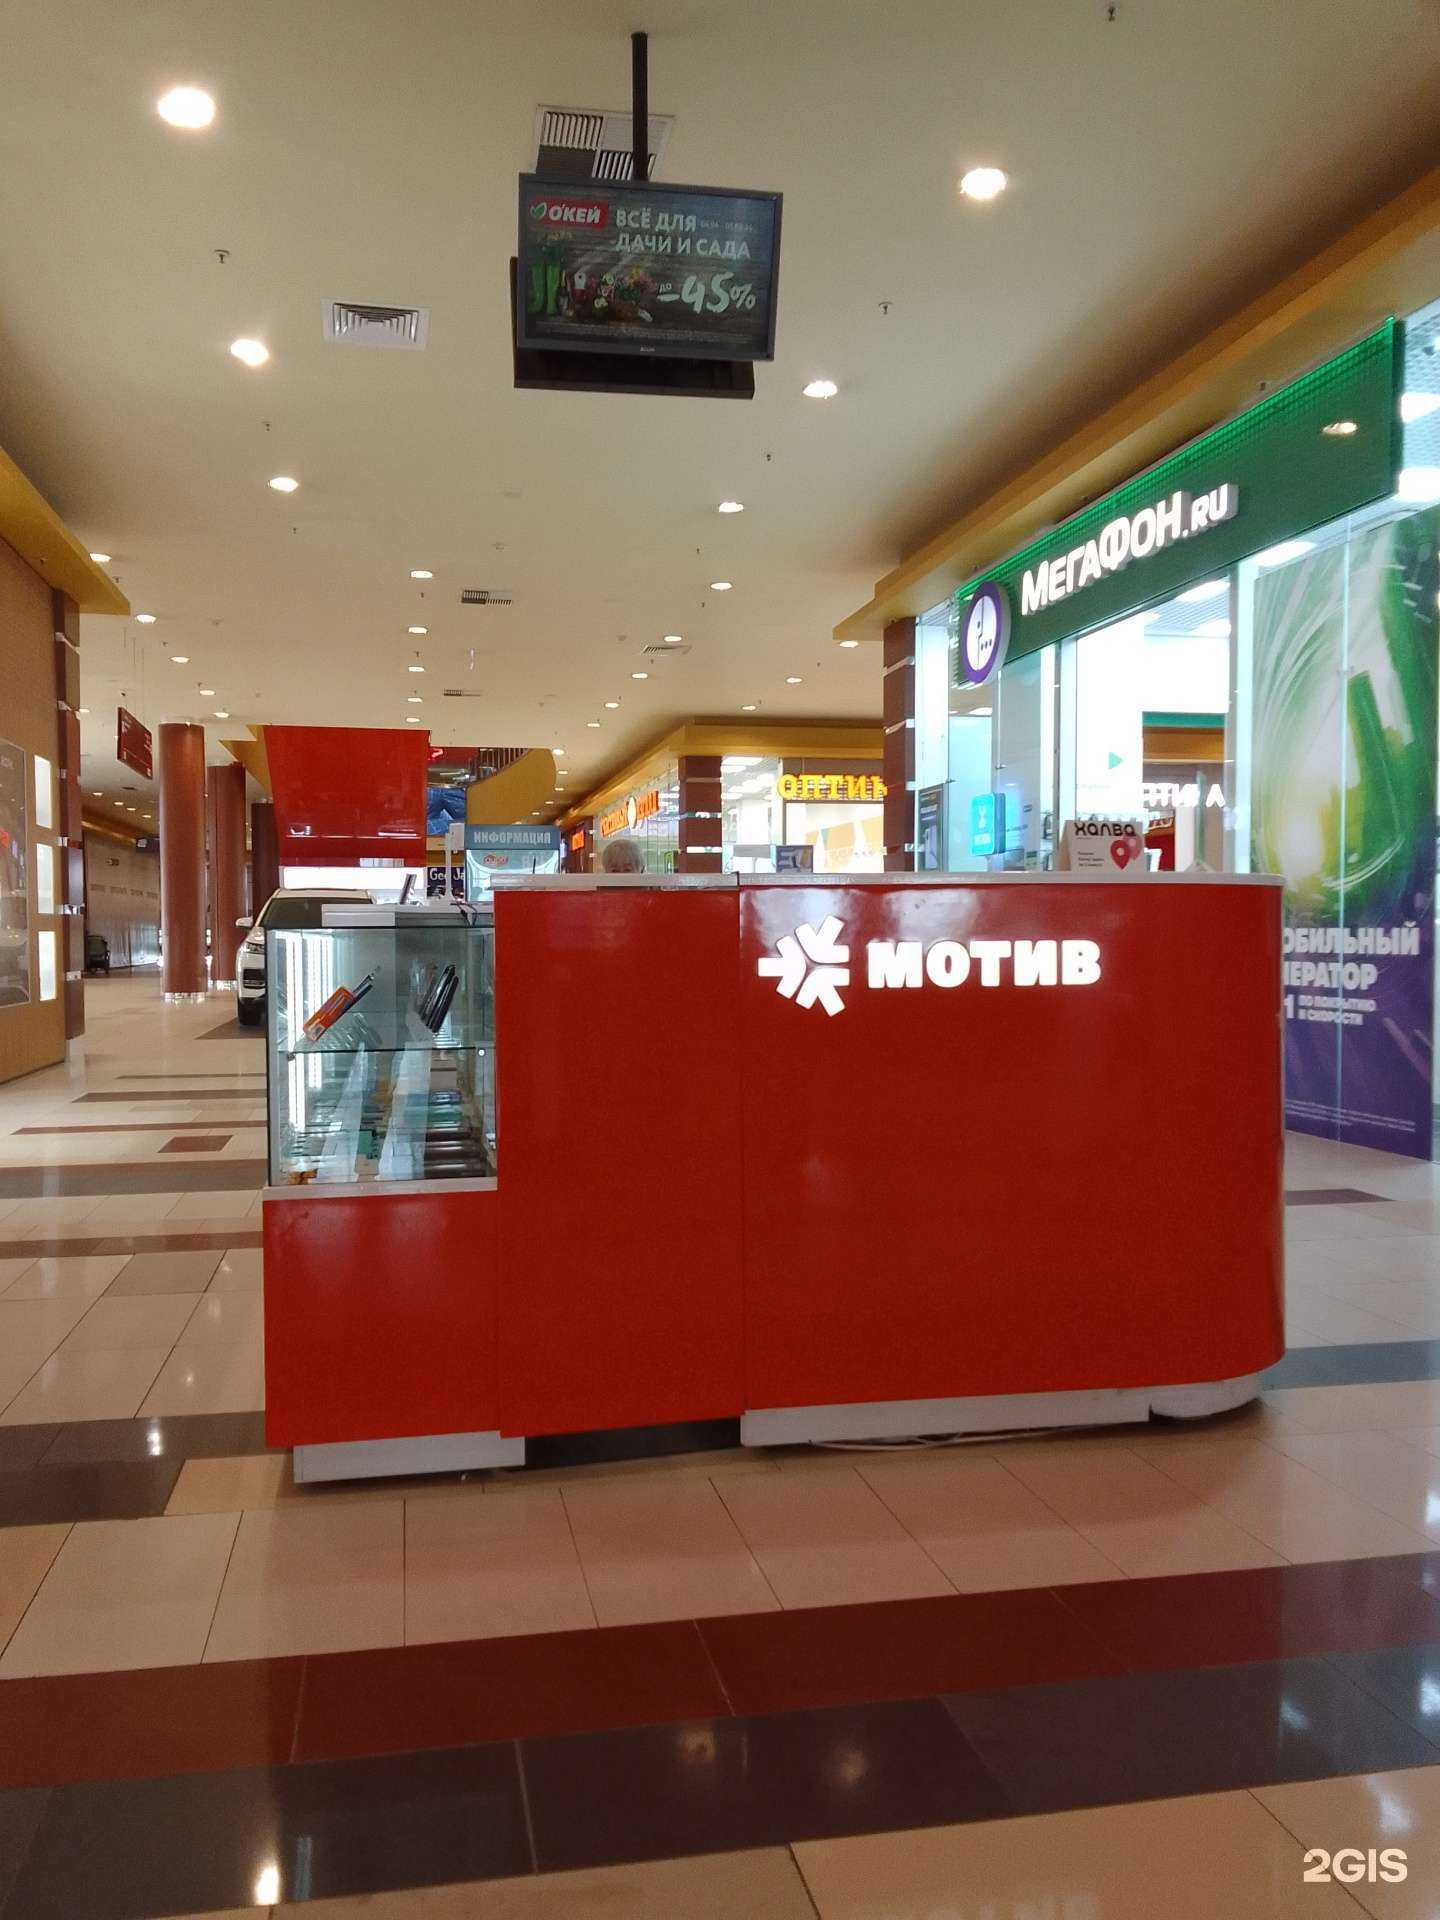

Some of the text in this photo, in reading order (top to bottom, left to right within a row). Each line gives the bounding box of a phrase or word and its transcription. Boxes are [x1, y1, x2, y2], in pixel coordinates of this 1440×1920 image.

[616, 207, 651, 228] ВСЁ
[656, 213, 697, 232] ДЛЯ
[612, 233, 751, 260] ДАЧИ И САДА
[473, 831, 551, 846] ИНФОРМАЦИЯ
[867, 939, 1102, 989] МОТИВ
